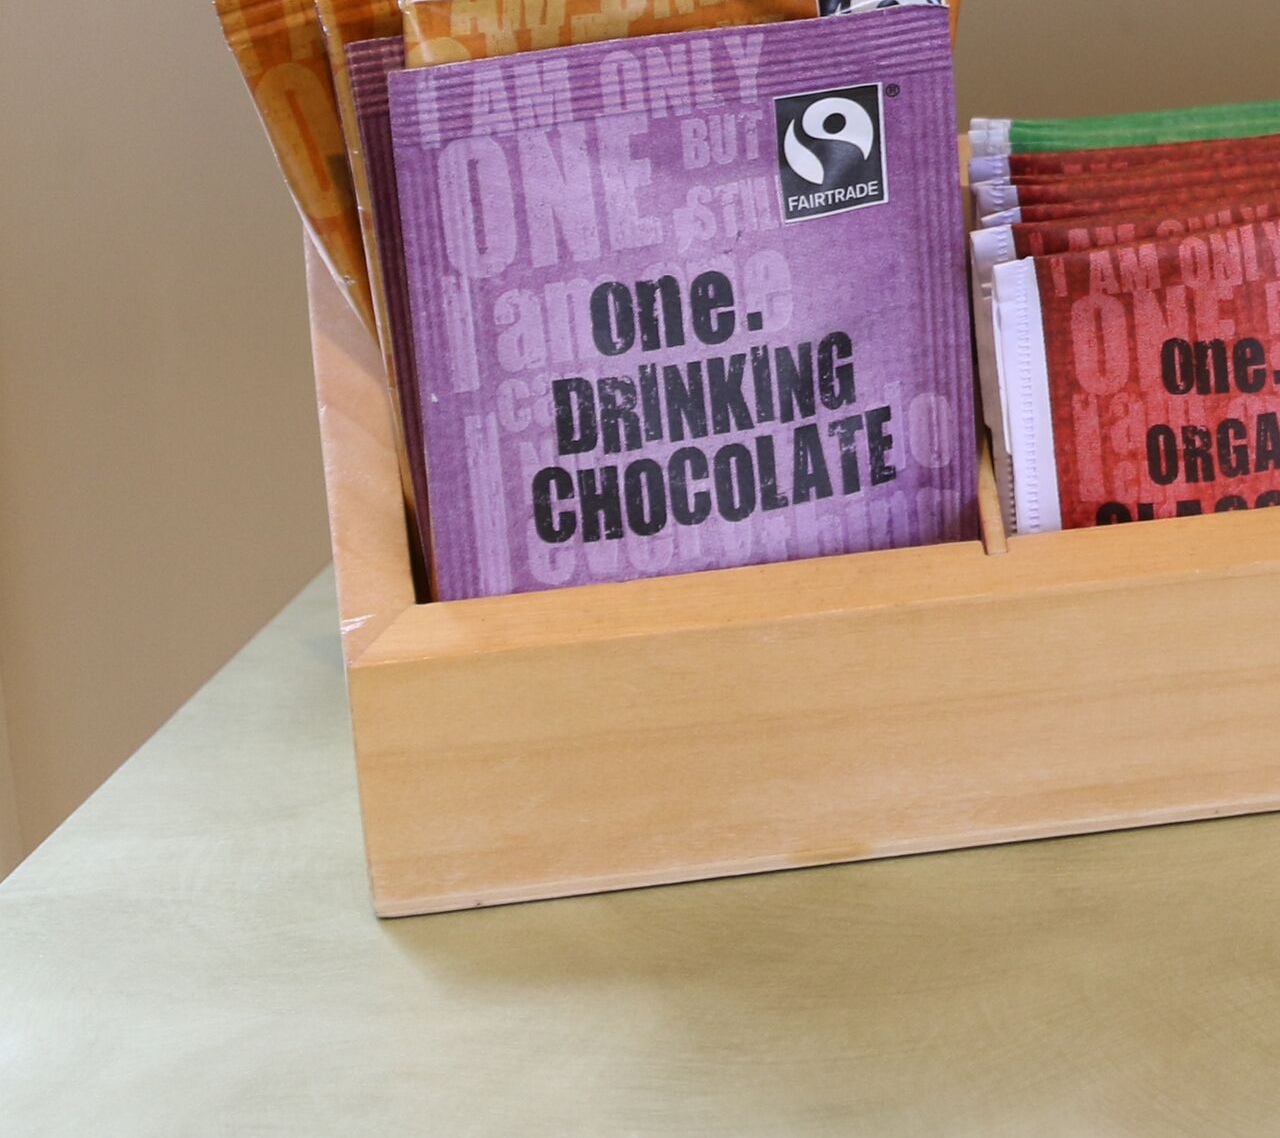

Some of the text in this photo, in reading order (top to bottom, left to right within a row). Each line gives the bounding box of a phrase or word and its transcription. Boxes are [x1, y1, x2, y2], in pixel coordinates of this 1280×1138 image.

[416, 74, 441, 149] I
[471, 57, 574, 134] AM
[601, 33, 764, 117] ONLY
[682, 111, 763, 170] BUT
[685, 175, 781, 242] STIL
[788, 181, 879, 211] FAIRTRADE
[1090, 243, 1161, 294] AM
[590, 270, 763, 357] one.
[552, 331, 855, 456] DRINKING
[531, 407, 897, 544] CHOCOLATE
